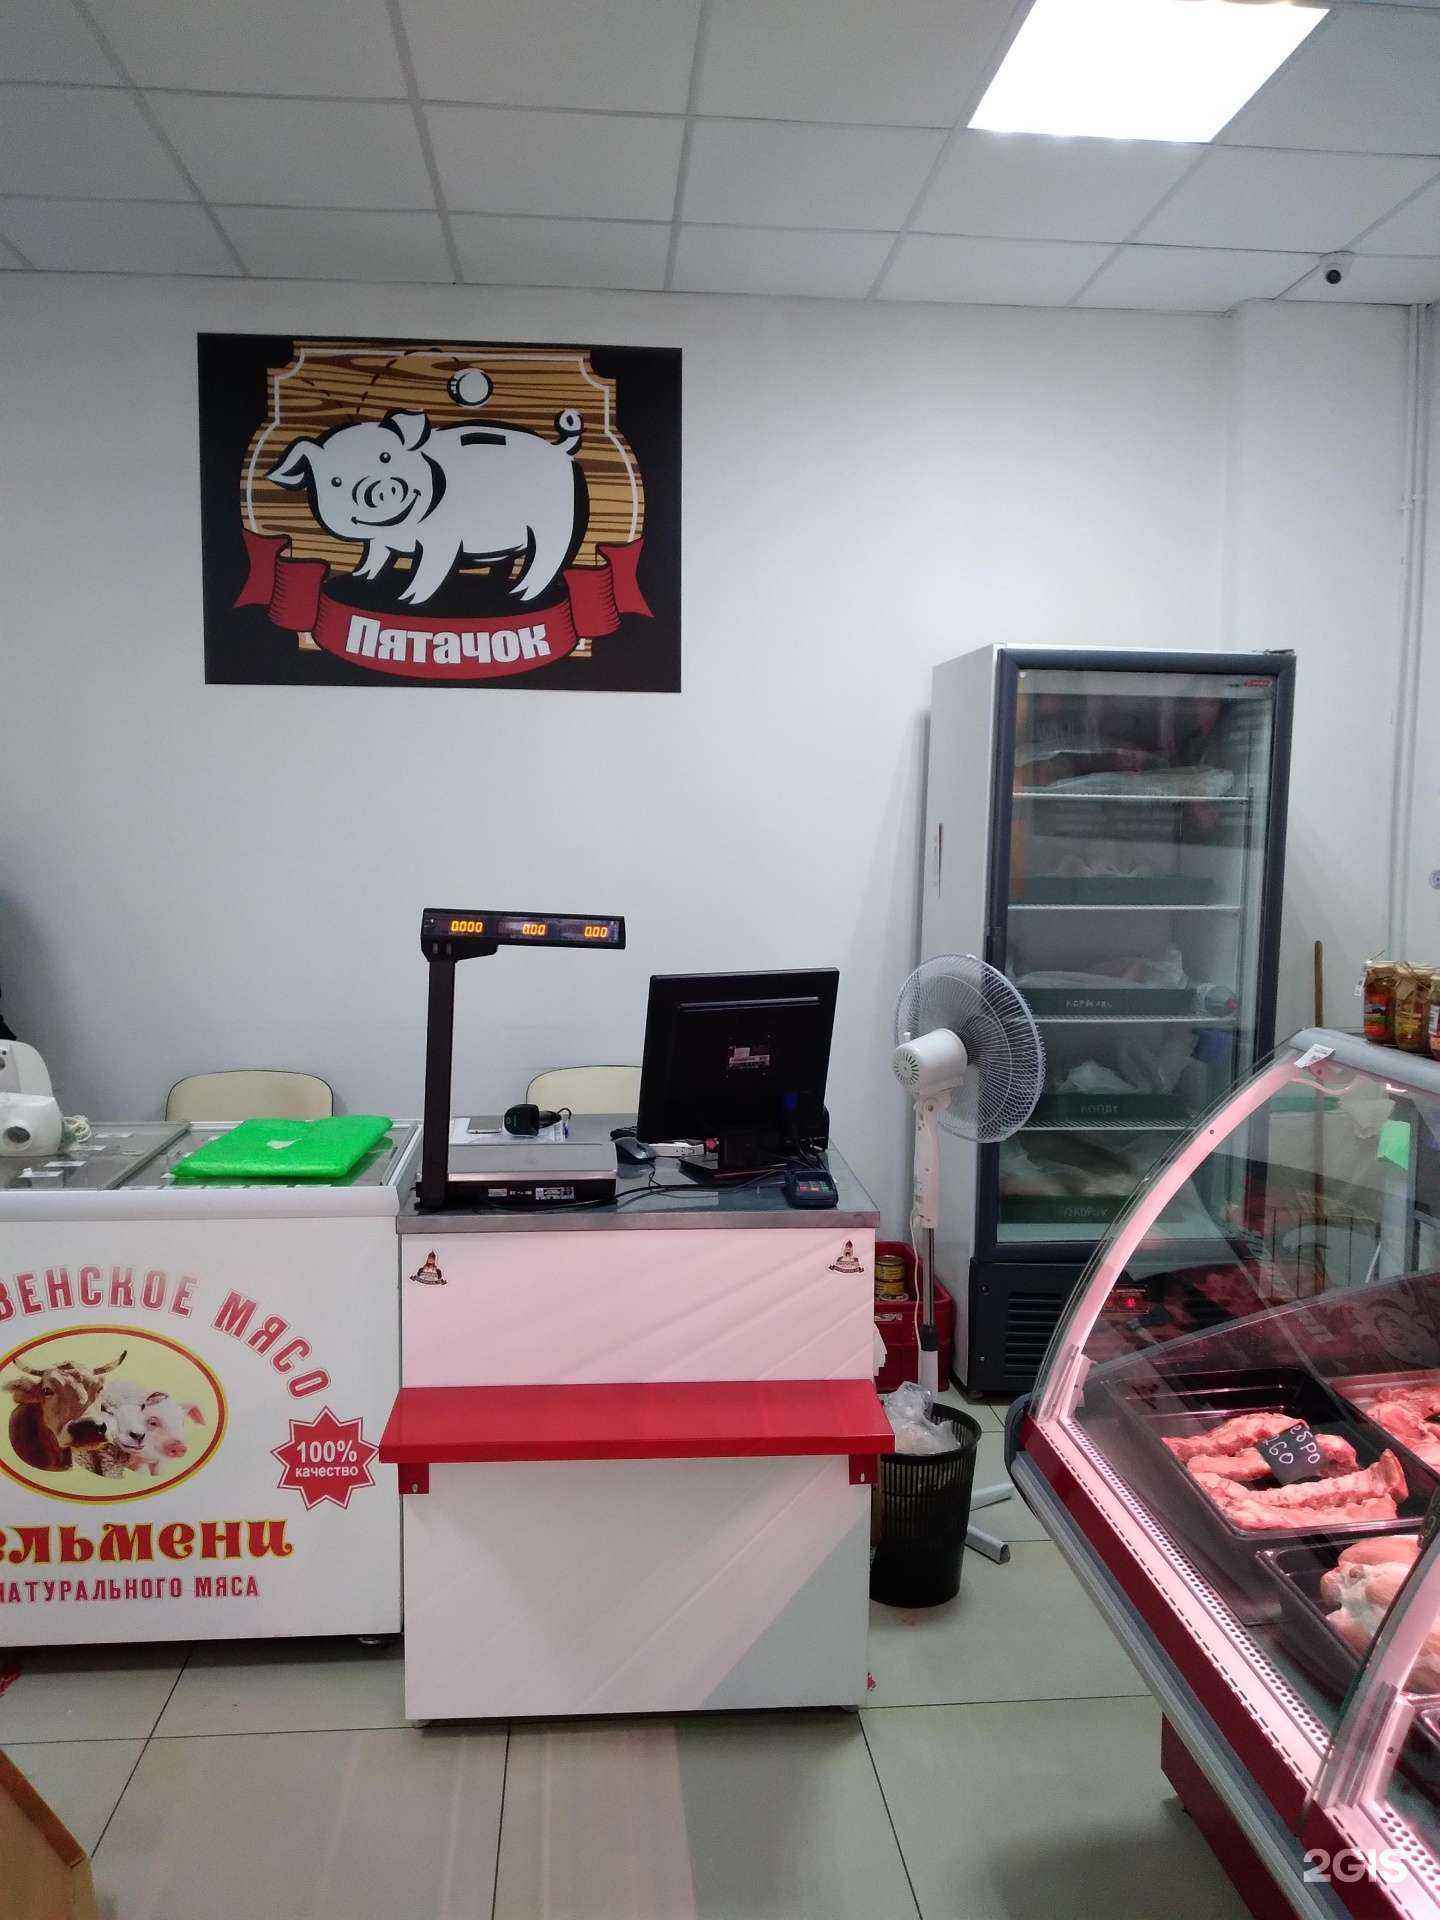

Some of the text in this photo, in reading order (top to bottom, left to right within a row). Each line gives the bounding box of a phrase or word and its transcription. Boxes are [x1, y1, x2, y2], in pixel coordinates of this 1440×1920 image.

[345, 615, 550, 664] Пятачок
[210, 1288, 331, 1399] МЯСО
[296, 1440, 357, 1463] 100%
[295, 1466, 359, 1478] качество
[0, 1519, 293, 1565] льмени
[195, 1575, 260, 1598] МЯСА
